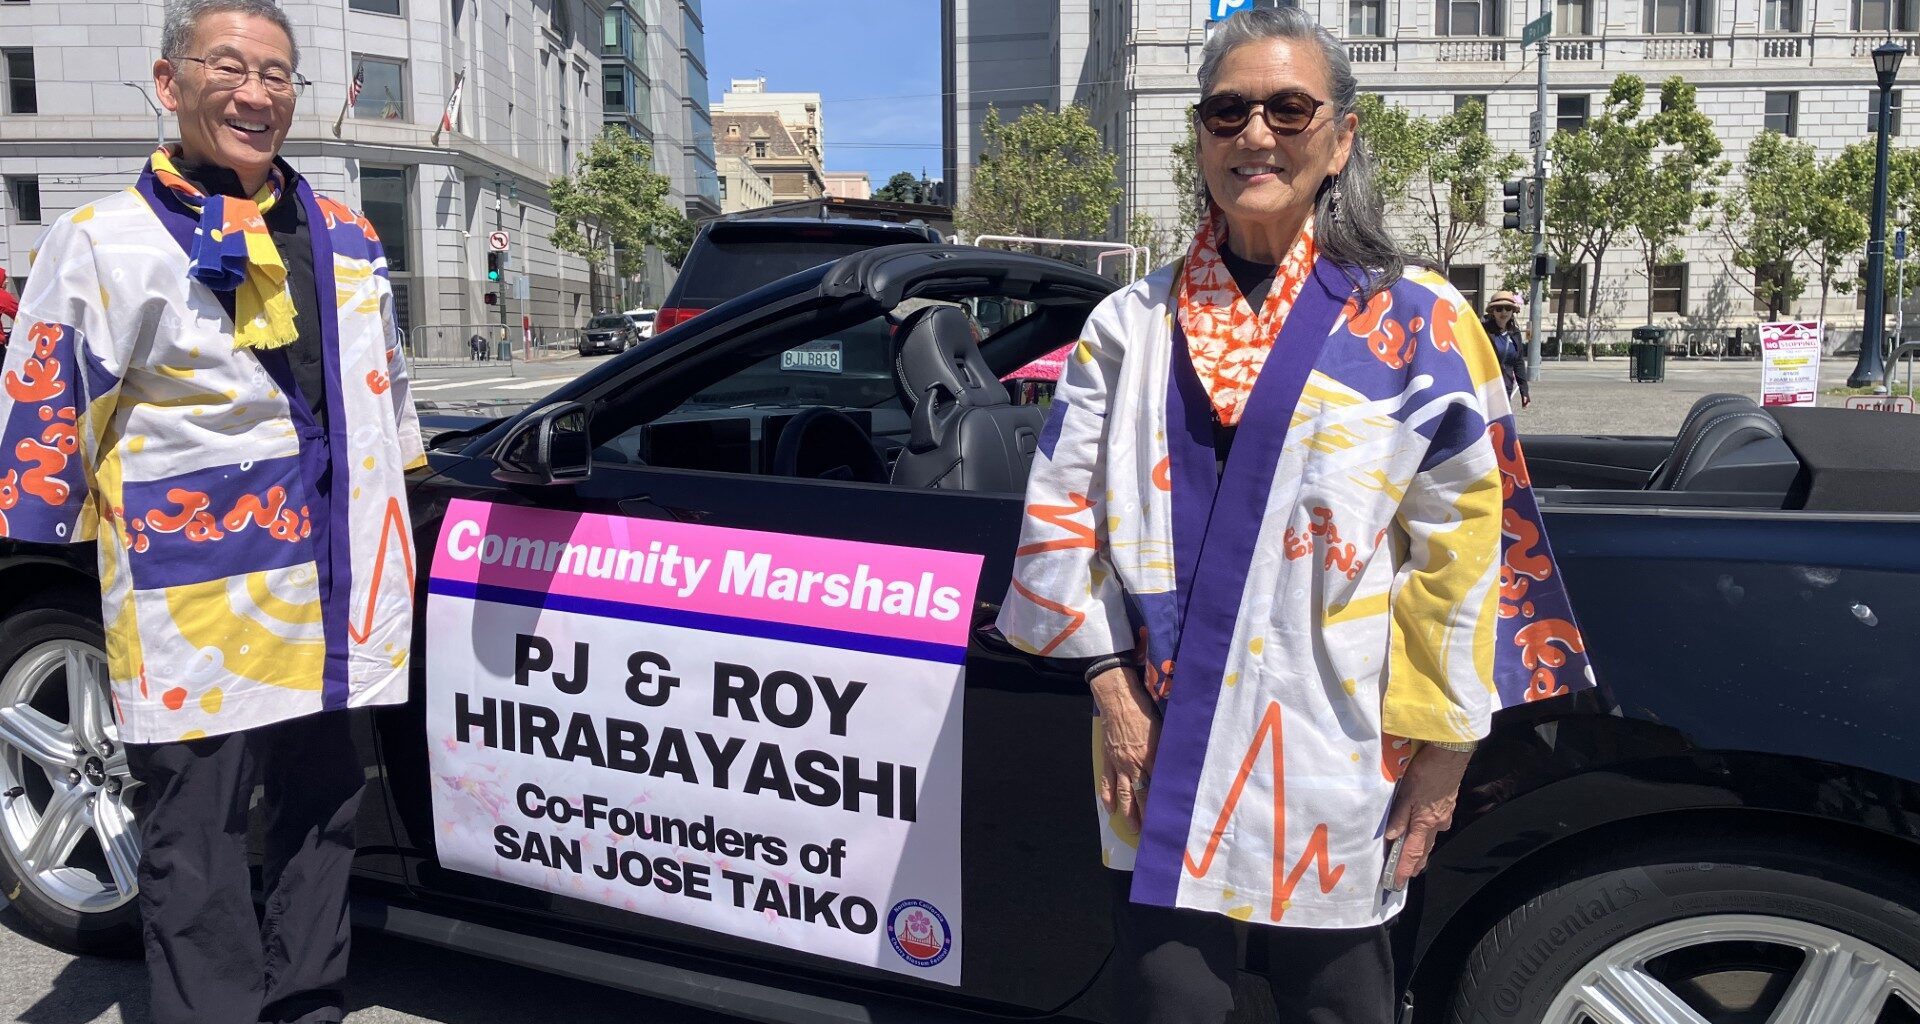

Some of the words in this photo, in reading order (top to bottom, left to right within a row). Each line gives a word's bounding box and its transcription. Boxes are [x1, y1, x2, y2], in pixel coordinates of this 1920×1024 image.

[1530, 129, 1541, 145] 20
[785, 352, 838, 367] 8JLB818
[1765, 341, 1779, 349] NO
[1780, 340, 1817, 349] STOPPING
[447, 519, 711, 598] Community
[718, 549, 962, 622] Marshals
[514, 633, 590, 696] PJ
[624, 650, 681, 707] &
[713, 661, 868, 737] ROY
[455, 692, 917, 823] HIRABAYASHI
[516, 782, 788, 866] Co-Founders
[799, 838, 846, 878] of
[493, 824, 583, 875] SAN
[593, 846, 712, 902] JOSE
[722, 869, 878, 935] TAIKO
[893, 900, 918, 913] Northern
[918, 900, 944, 923] California
[891, 937, 905, 960] Cherry
[930, 947, 949, 965] Festival
[1492, 886, 1619, 1018] Continental
